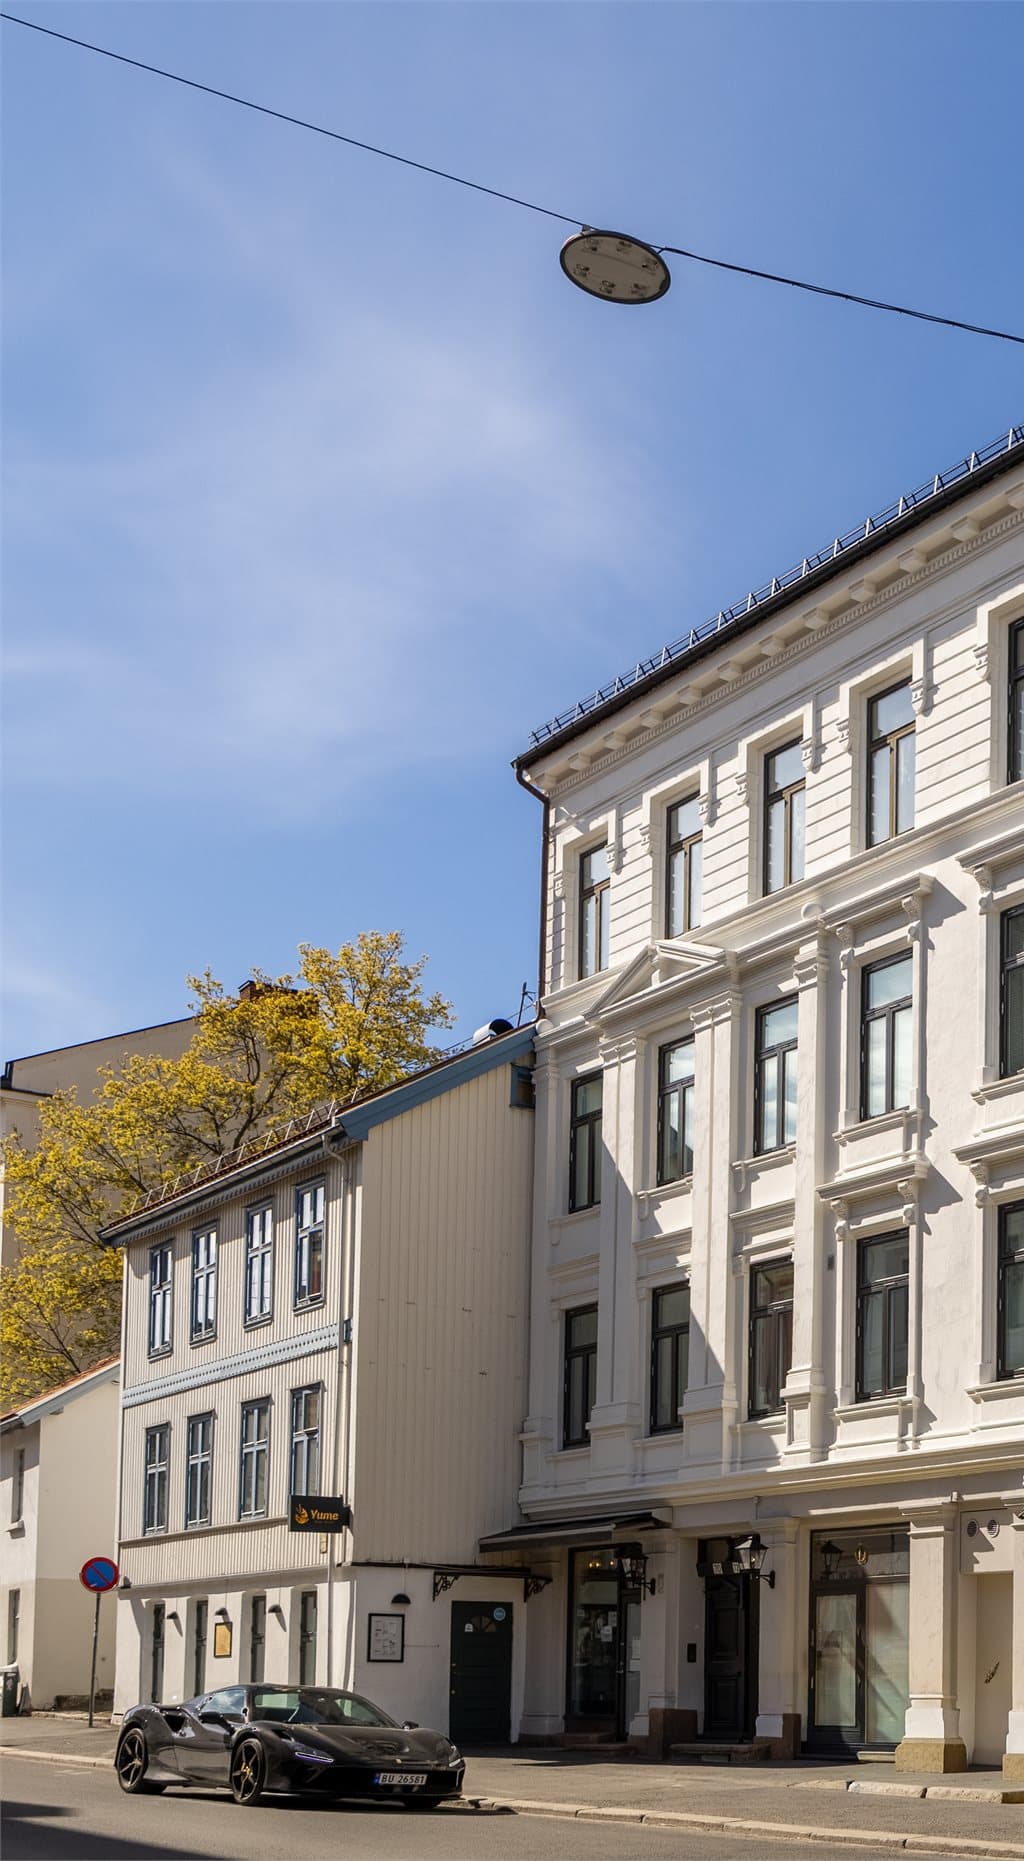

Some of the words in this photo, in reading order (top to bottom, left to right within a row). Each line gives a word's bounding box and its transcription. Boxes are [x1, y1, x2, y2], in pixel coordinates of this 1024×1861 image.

[310, 1509, 339, 1521] Yume
[381, 1774, 395, 1783] BU
[397, 1775, 425, 1784] 26581
